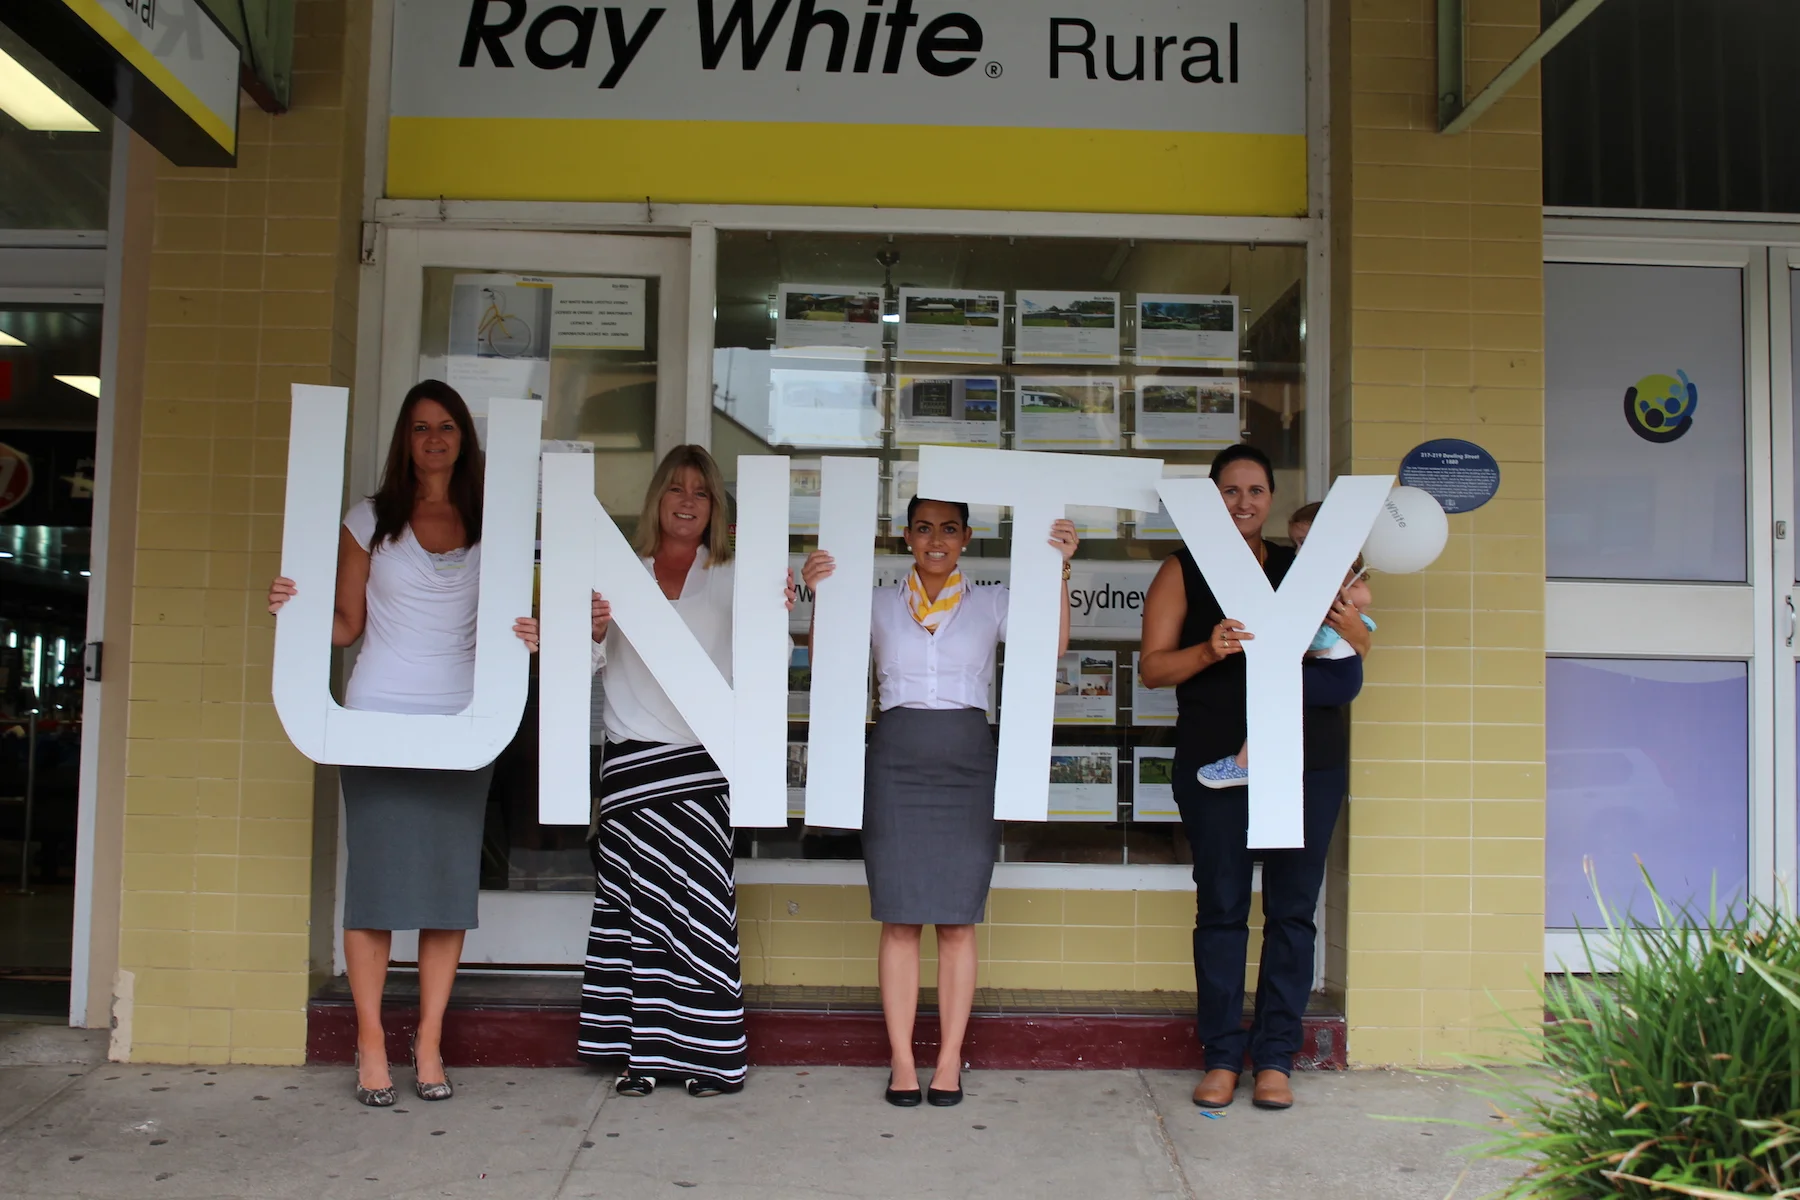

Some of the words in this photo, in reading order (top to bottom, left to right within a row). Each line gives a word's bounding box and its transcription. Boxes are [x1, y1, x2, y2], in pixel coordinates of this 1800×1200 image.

[458, 0, 667, 89] Ray
[696, 0, 984, 77] White
[1047, 16, 1240, 84] Rural
[1385, 501, 1407, 528] White
[272, 382, 1398, 850] UNITY
